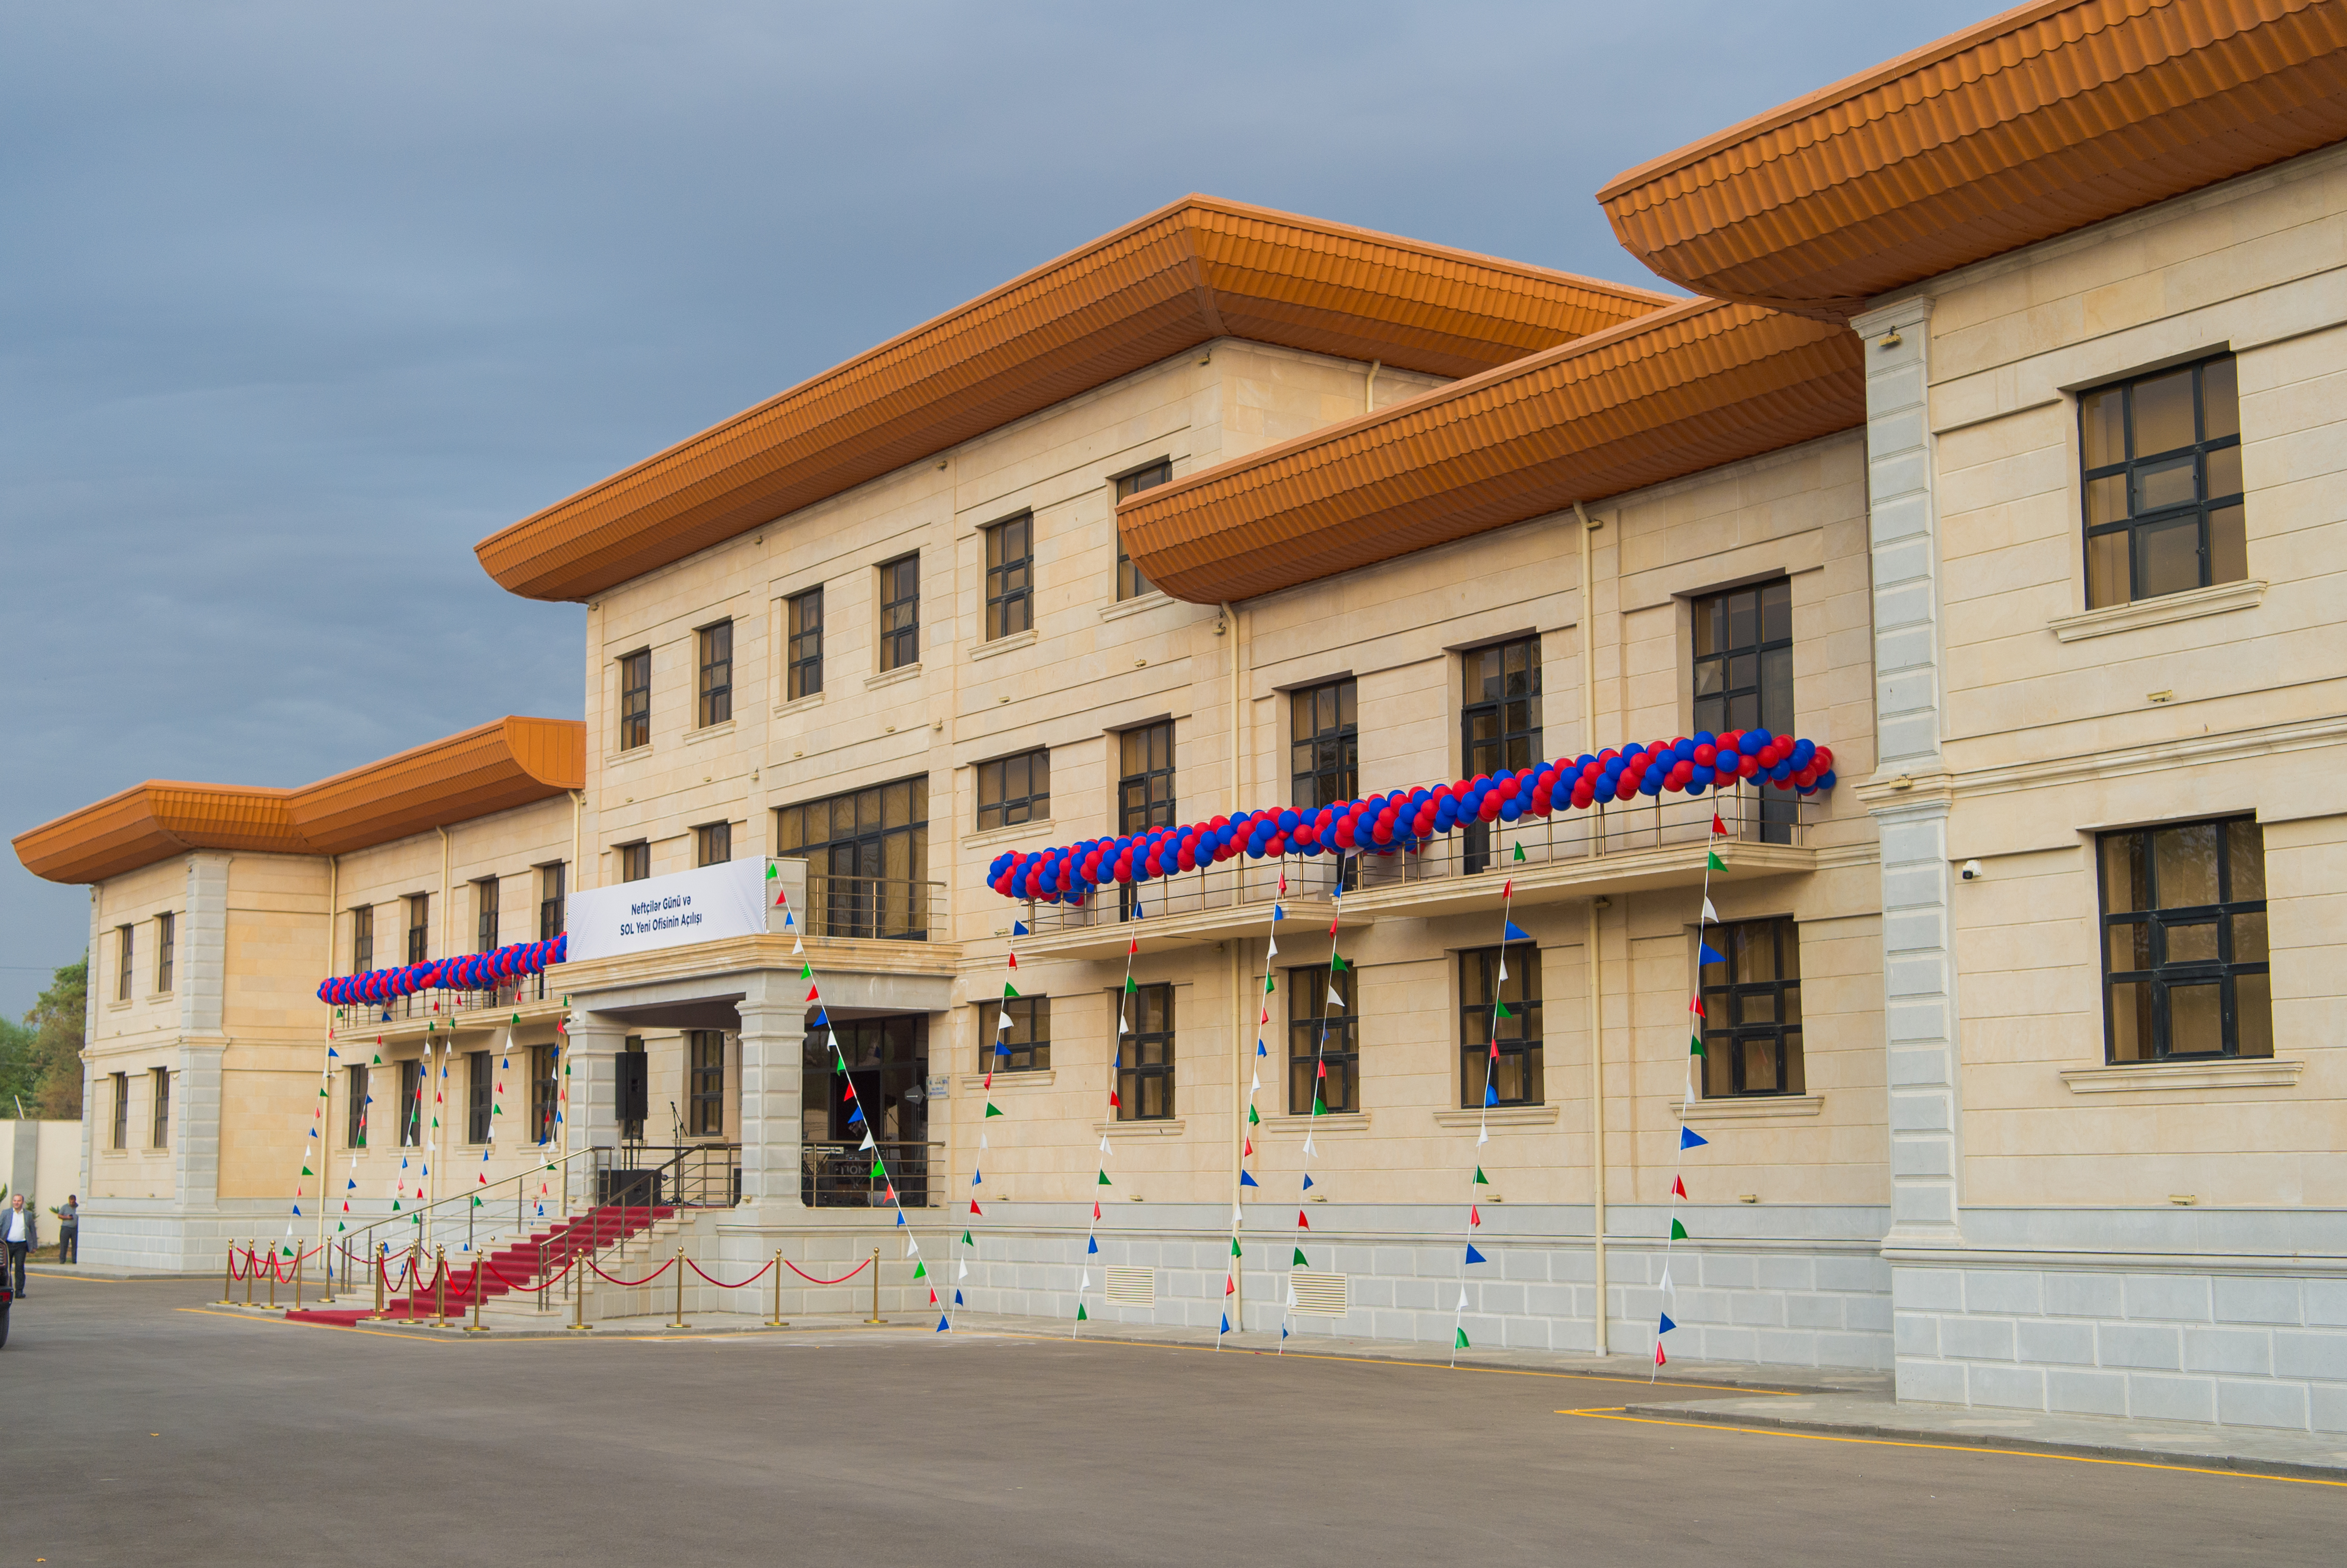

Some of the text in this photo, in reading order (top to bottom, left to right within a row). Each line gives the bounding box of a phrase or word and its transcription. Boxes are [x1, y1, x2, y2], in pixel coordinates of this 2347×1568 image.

[631, 895, 691, 915] Neftçilər Günü və
[620, 912, 702, 936] SOL Yeni Ofisinin Açılışı
